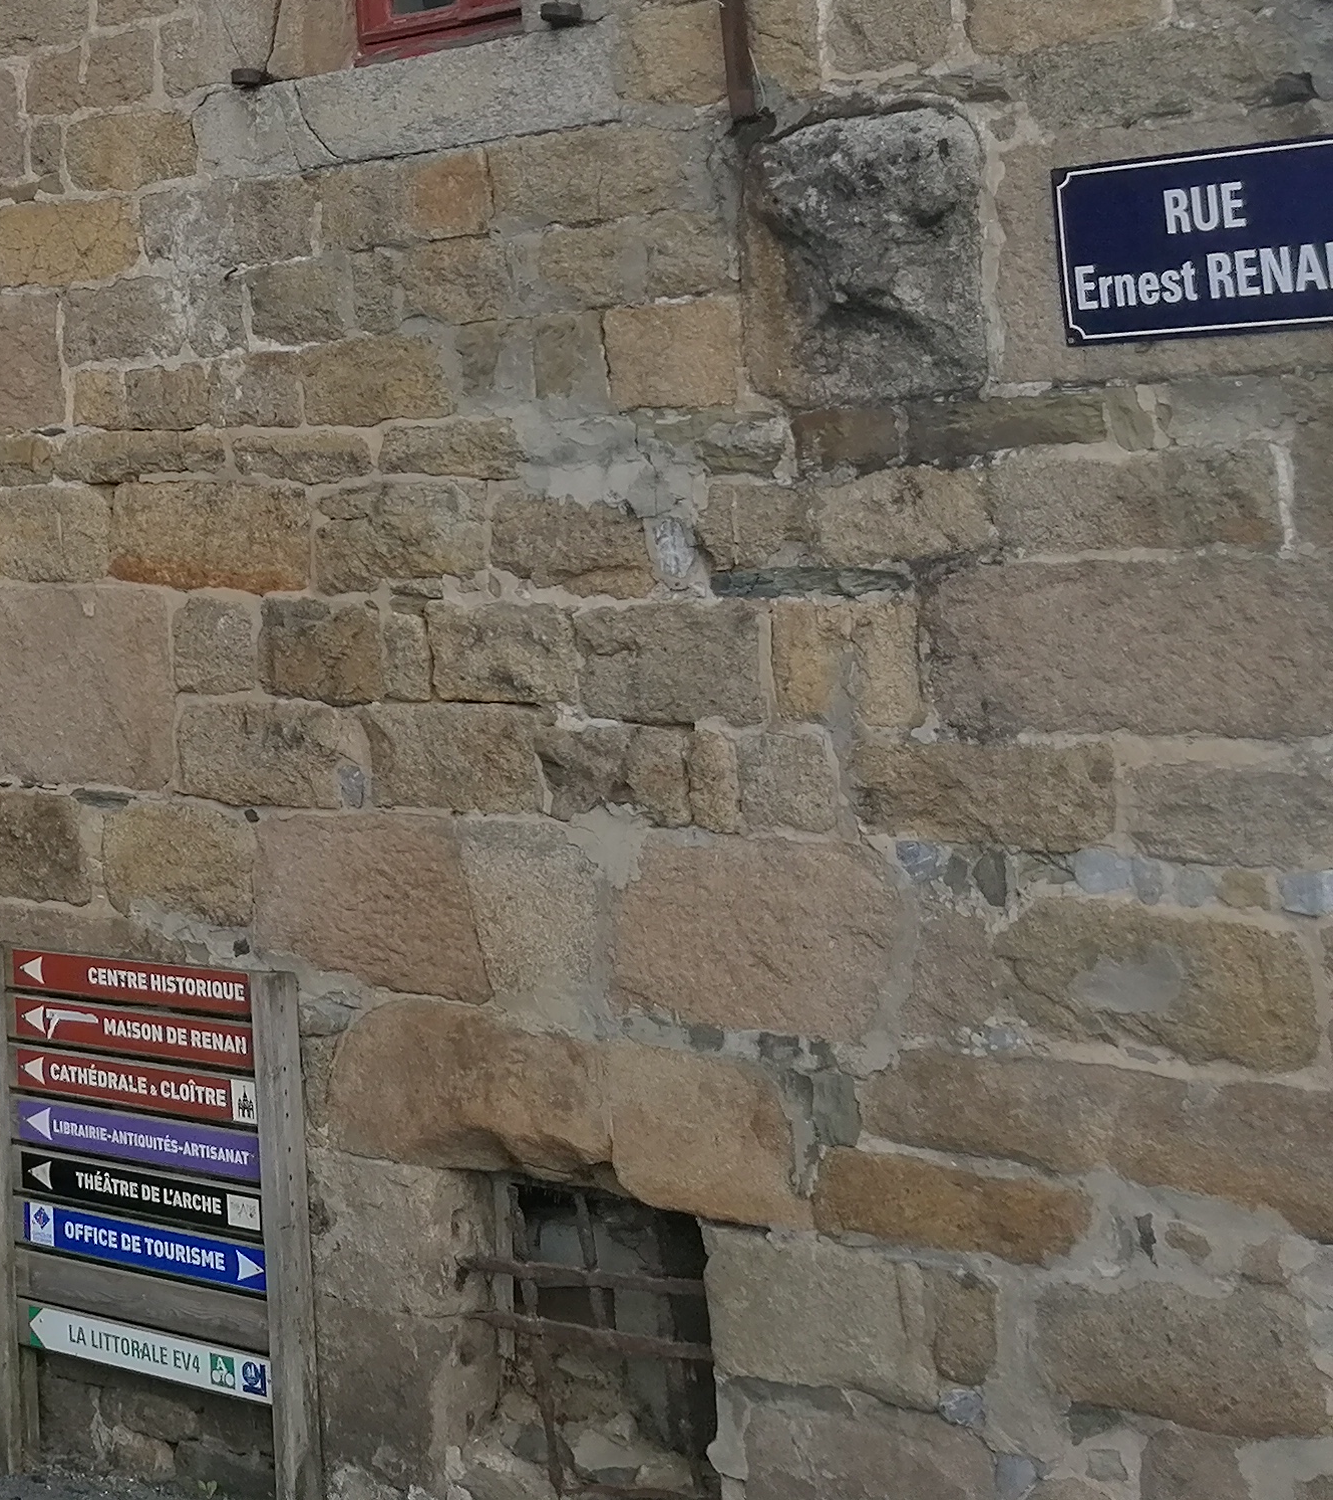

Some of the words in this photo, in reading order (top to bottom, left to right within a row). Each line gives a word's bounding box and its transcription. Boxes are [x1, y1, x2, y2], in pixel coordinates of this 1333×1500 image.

[1163, 181, 1247, 235] RUE
[1074, 261, 1199, 311] Ernest
[1206, 242, 1333, 299] RENA
[87, 966, 148, 991] CENTRE
[151, 973, 245, 1002] HISTORIQUE
[103, 1018, 163, 1043] MAISON
[165, 1026, 189, 1046] DE
[191, 1029, 247, 1055] RENAN
[49, 1062, 148, 1096] CATHÉDRALE
[149, 1084, 158, 1097] &
[160, 1078, 227, 1107] CLOÎTRE
[52, 1119, 250, 1166] LIBRAIRIE-ANTIQUITÉS-ARTISANAT
[75, 1170, 139, 1200] THÉÂTRE
[140, 1183, 161, 1204] DE
[162, 1186, 222, 1215] L'ARCHE
[64, 1220, 118, 1250] OFFICE
[120, 1232, 142, 1254] DE
[144, 1237, 226, 1271] TOURISME
[68, 1322, 88, 1346] LA
[90, 1326, 169, 1367] LITTORALE
[172, 1345, 201, 1374] EV4
